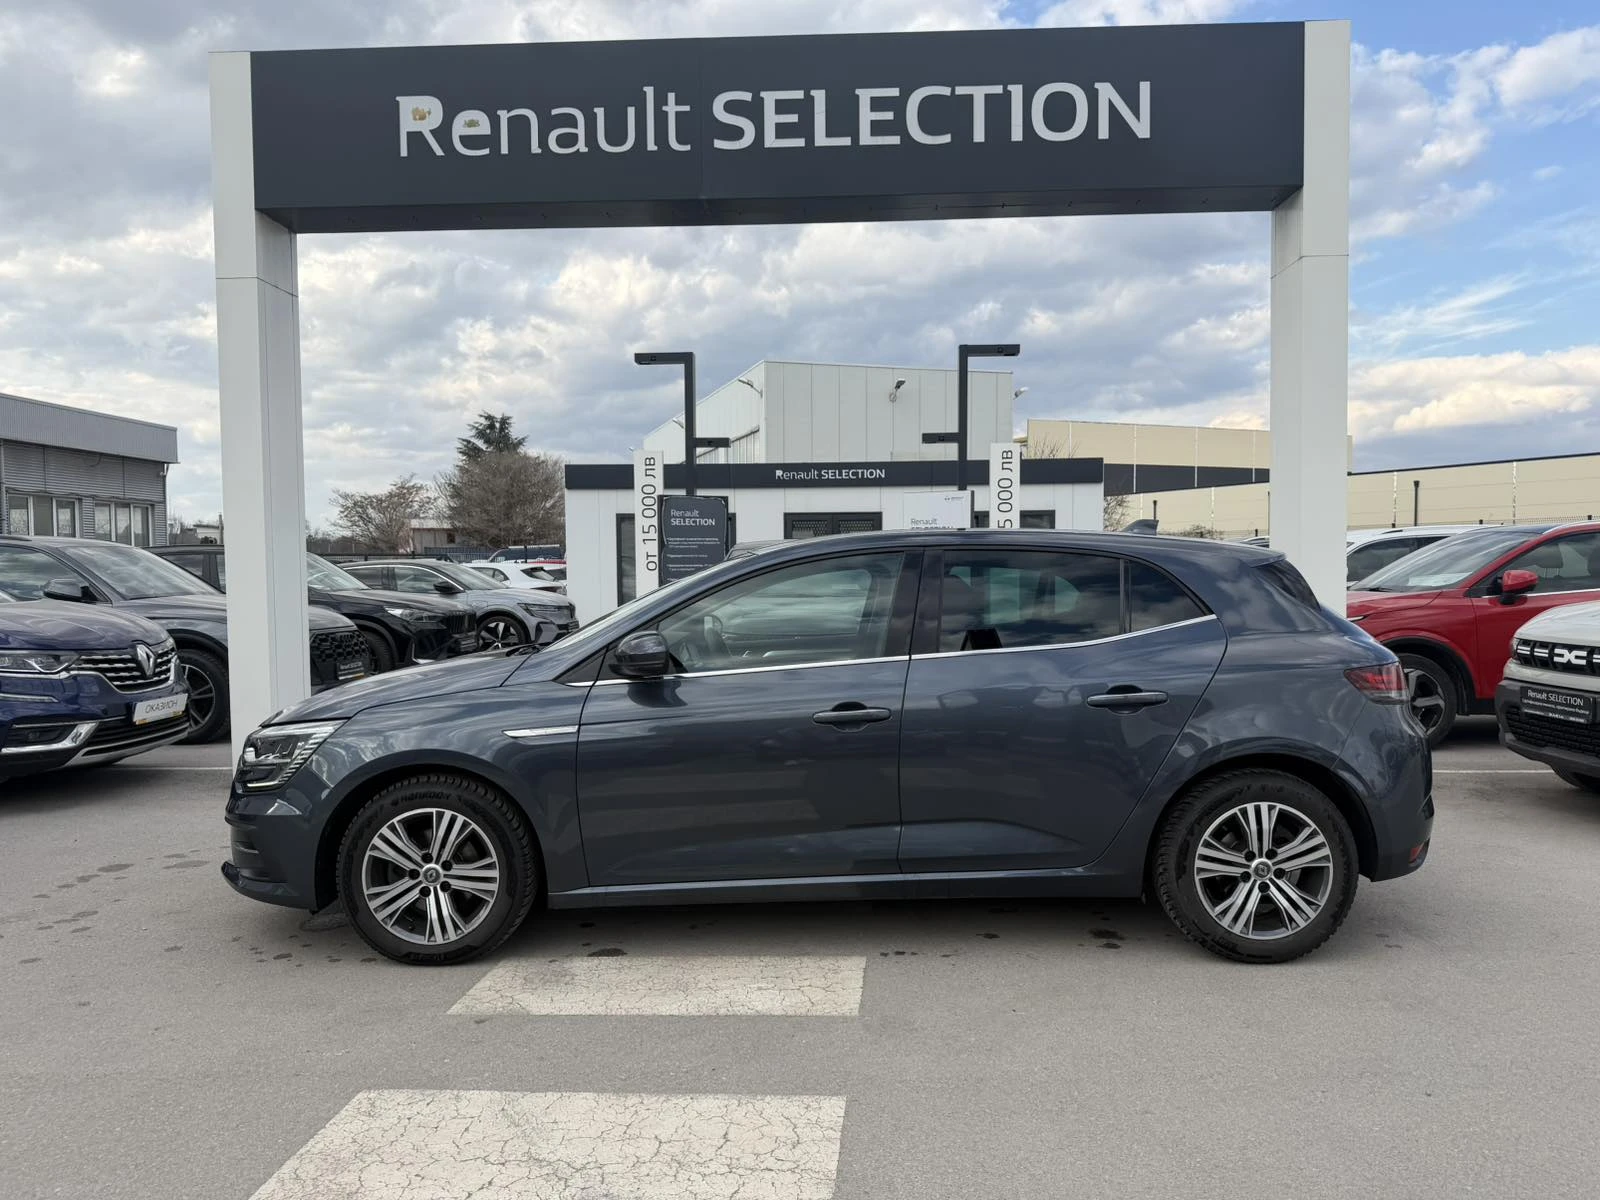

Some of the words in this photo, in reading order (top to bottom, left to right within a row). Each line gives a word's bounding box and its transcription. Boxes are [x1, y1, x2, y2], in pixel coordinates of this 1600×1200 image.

[396, 86, 691, 157] Renault
[712, 81, 1151, 150] SELECTION
[775, 468, 819, 480] Renault
[821, 468, 886, 479] SELECTION
[641, 484, 657, 518] 000
[997, 478, 1013, 513] 000
[670, 509, 699, 517] Renault
[670, 518, 715, 526] SELECTION
[910, 518, 937, 526] Renault
[642, 524, 657, 544] 15
[1528, 690, 1547, 700] Renault
[1548, 693, 1584, 706] SELECTION
